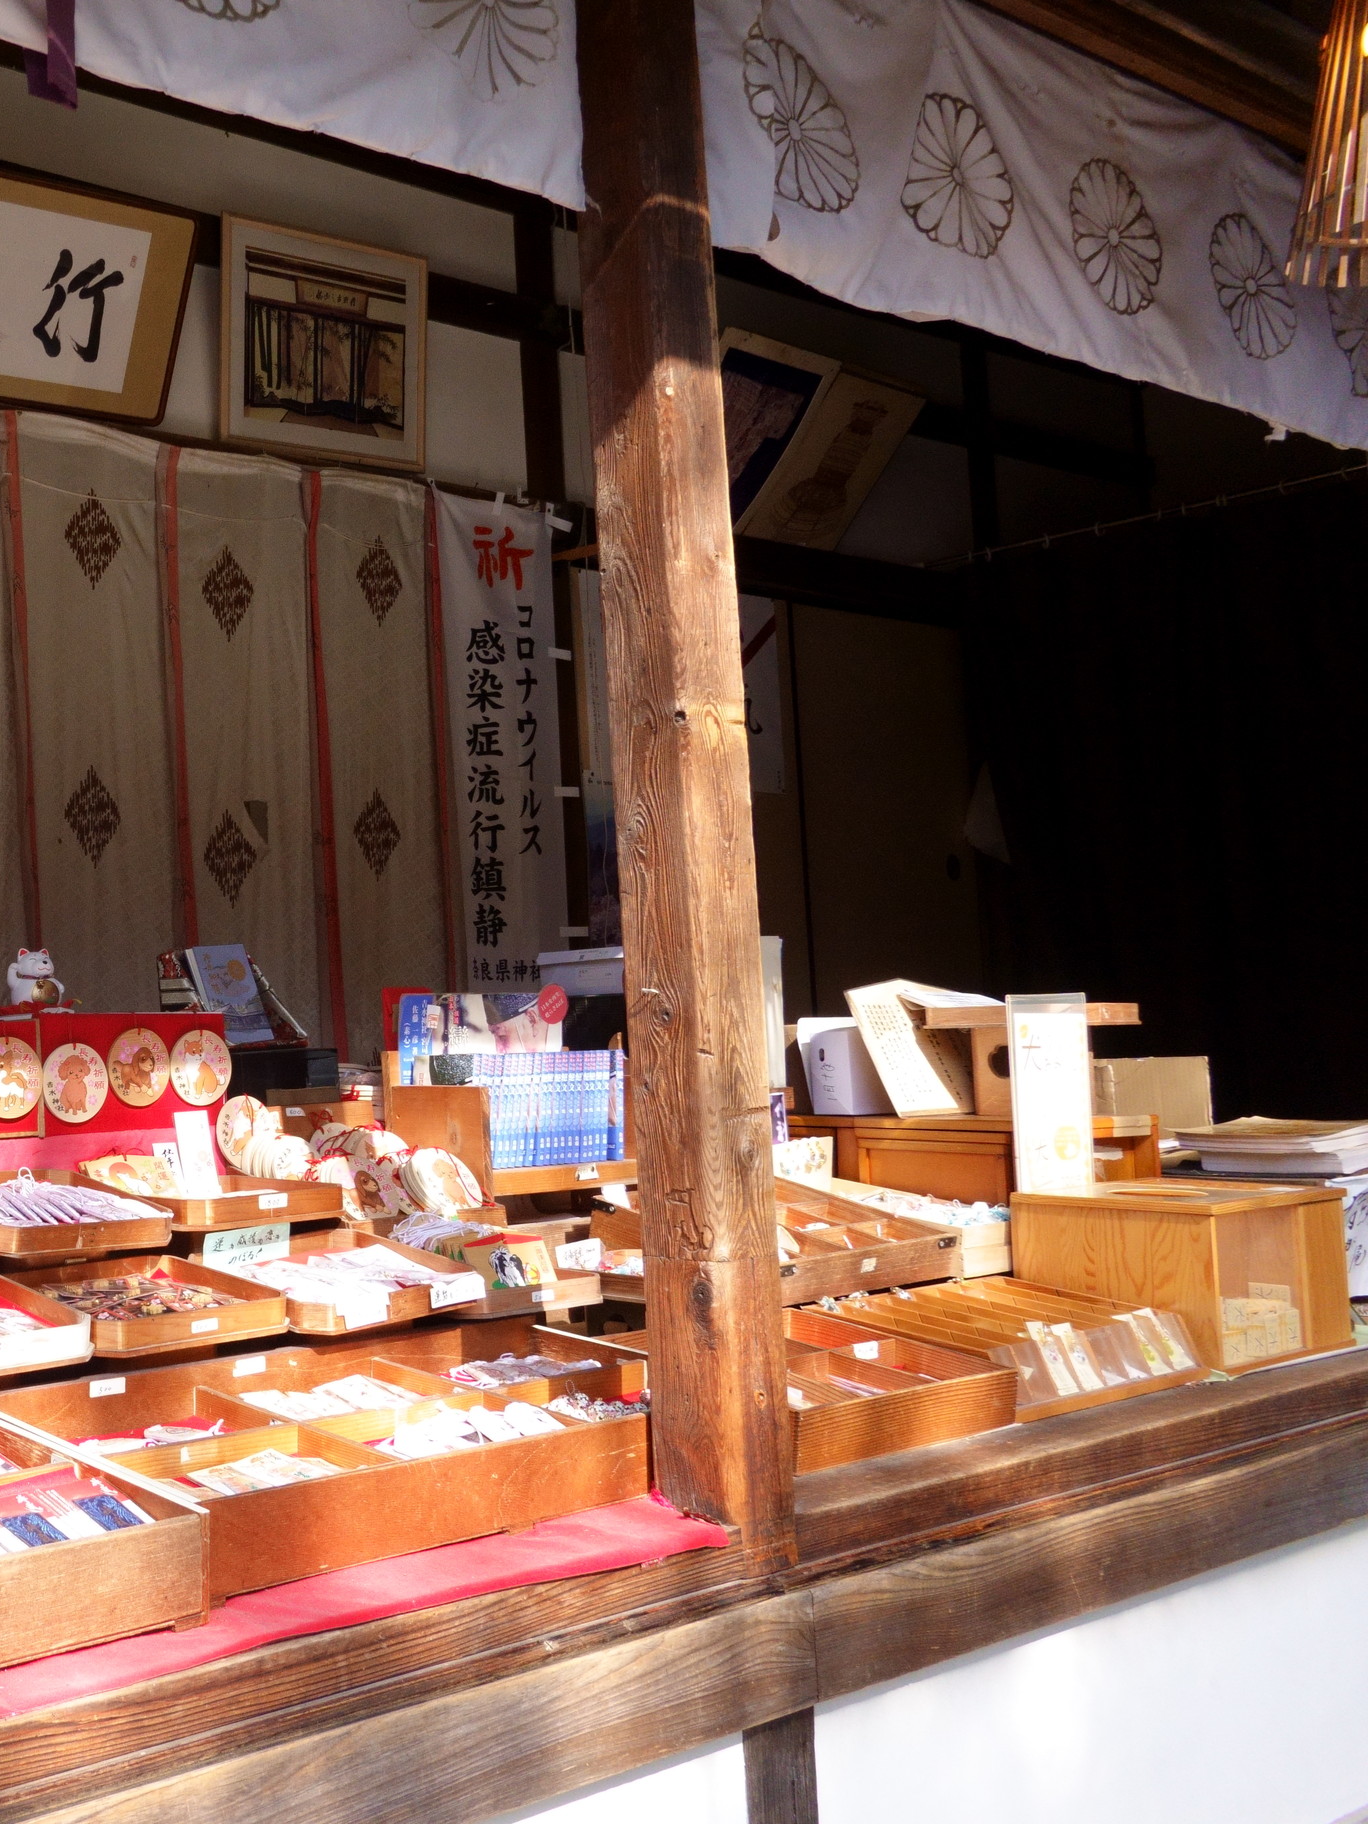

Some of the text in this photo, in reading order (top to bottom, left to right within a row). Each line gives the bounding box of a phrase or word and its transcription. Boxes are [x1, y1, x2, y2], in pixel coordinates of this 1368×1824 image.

[472, 526, 533, 591] 祈
[465, 620, 507, 949] 感染症流行鎮静
[516, 604, 543, 857] コロナウイルス
